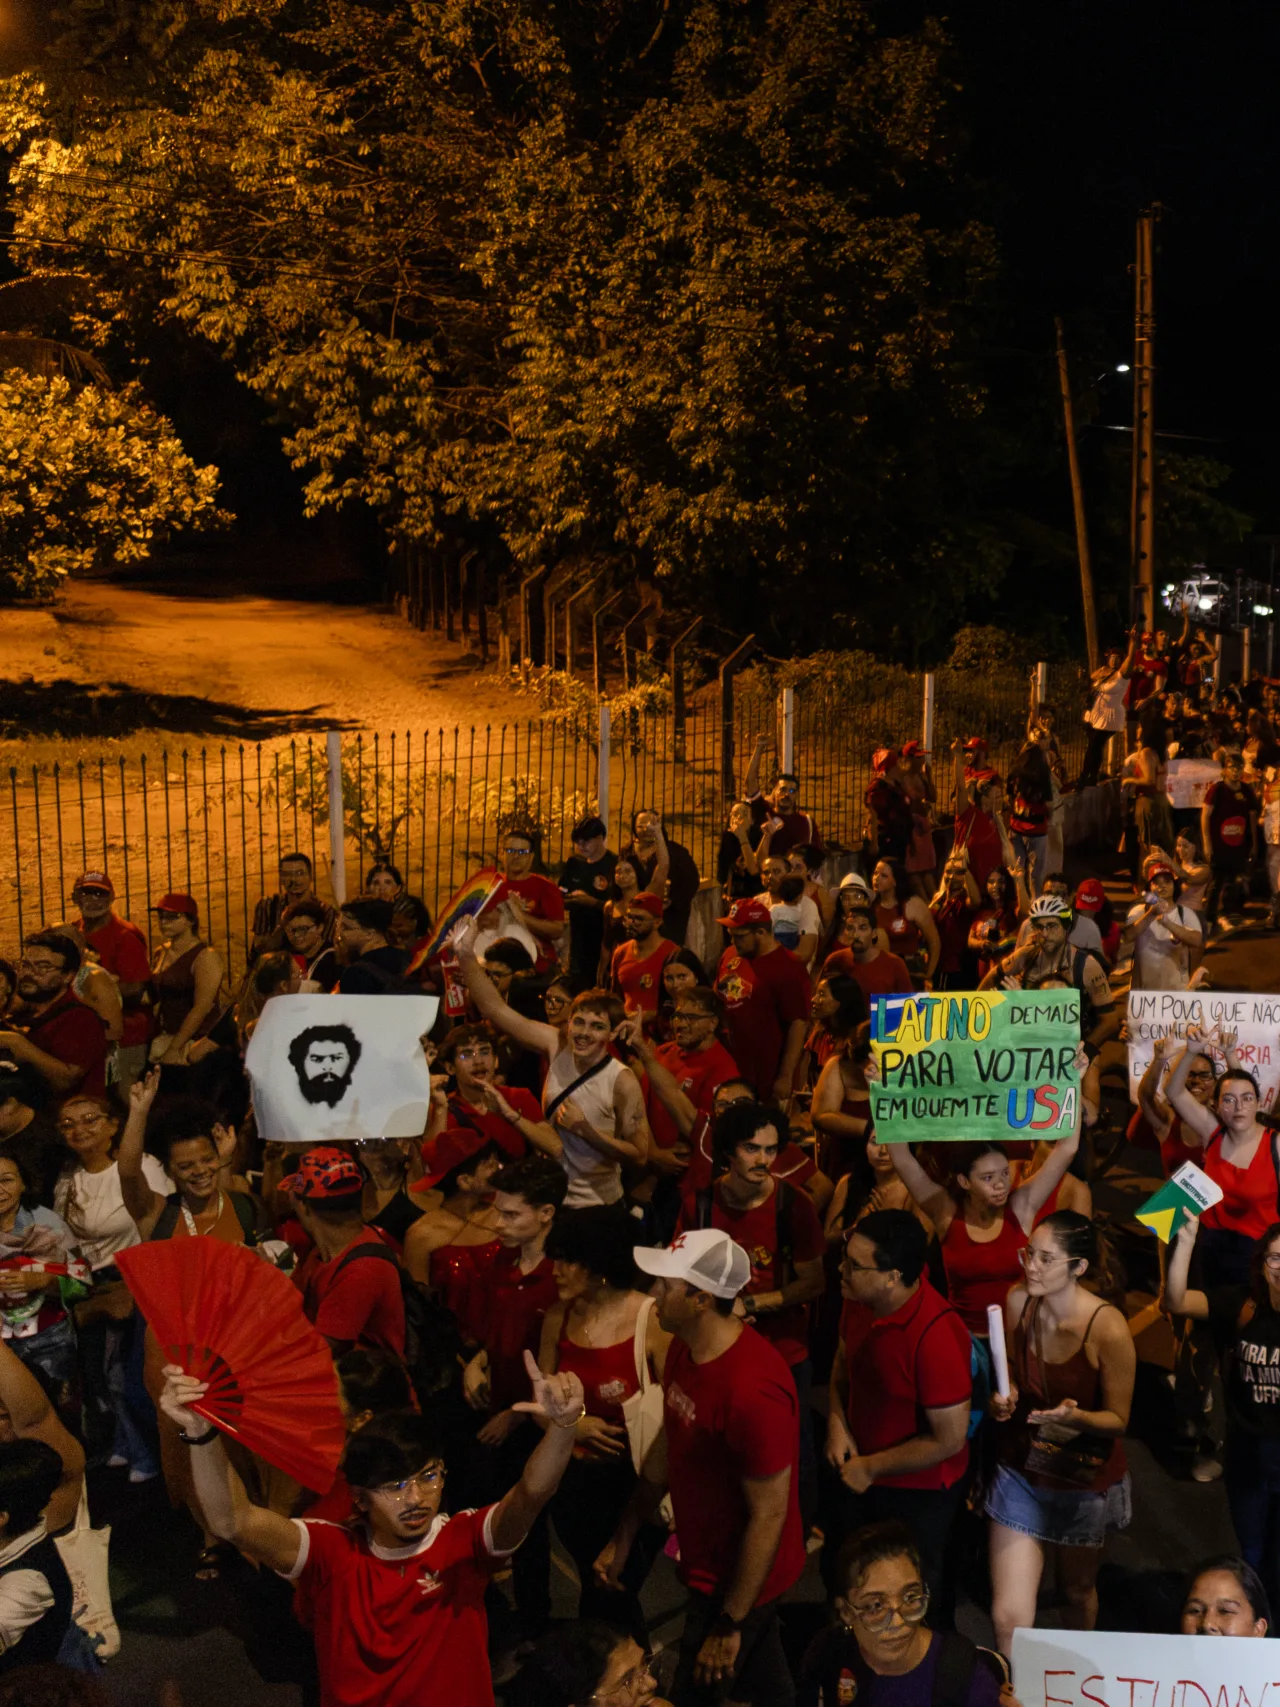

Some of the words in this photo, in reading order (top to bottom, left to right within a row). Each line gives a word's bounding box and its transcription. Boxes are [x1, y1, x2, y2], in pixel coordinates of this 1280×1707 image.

[877, 997, 992, 1043] LATINO
[1010, 1003, 1080, 1025] DEMAIS
[1131, 995, 1157, 1020] UM
[1161, 994, 1202, 1021] POVO
[1210, 1001, 1247, 1023] QUE
[882, 1046, 955, 1088] PARA
[974, 1047, 1077, 1083] VOTAR
[876, 1097, 907, 1121] EM
[911, 1096, 969, 1118] QUEM
[972, 1095, 1000, 1117] TE
[1007, 1084, 1077, 1130] USA
[1240, 1340, 1268, 1366] TIRA
[1269, 1347, 1280, 1366] A
